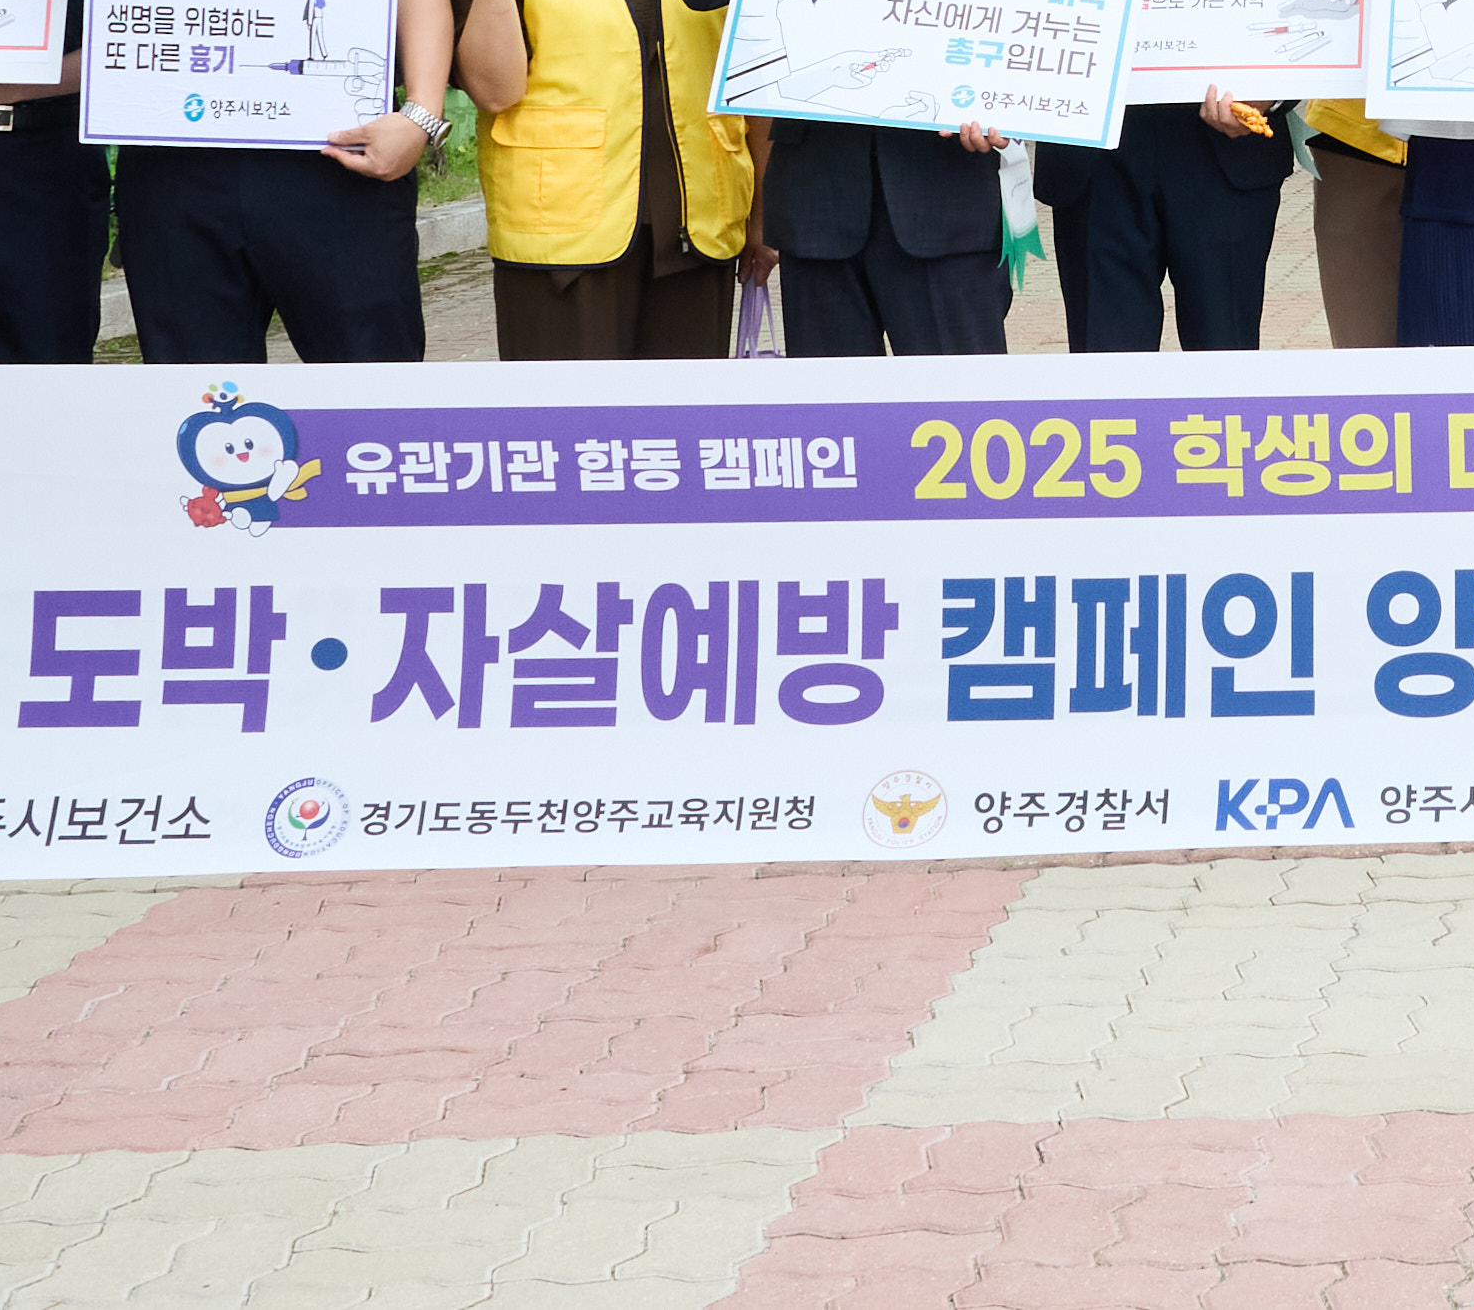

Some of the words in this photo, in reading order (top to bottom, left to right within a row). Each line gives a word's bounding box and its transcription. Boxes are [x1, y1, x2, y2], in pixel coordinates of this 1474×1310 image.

[106, 5, 175, 35] 생명을
[184, 7, 276, 38] 위협하는
[1012, 8, 1102, 45] 겨누는
[105, 42, 127, 70] 또
[136, 43, 180, 72] 다른
[189, 44, 235, 74] 흉기
[944, 36, 1097, 79] 총구입니다
[210, 99, 292, 120] 양주시보건소
[980, 88, 1090, 118] 양주시보건소
[344, 439, 559, 496] 유관기관
[574, 438, 682, 492] 합동
[698, 435, 858, 492] 캠페인
[909, 417, 1144, 503] 2025
[1170, 410, 1414, 497] 학생의
[940, 570, 1316, 722] 캠페인
[359, 792, 817, 838] 경기도동두천양주교육지원청
[973, 785, 1171, 833] 양주경찰서
